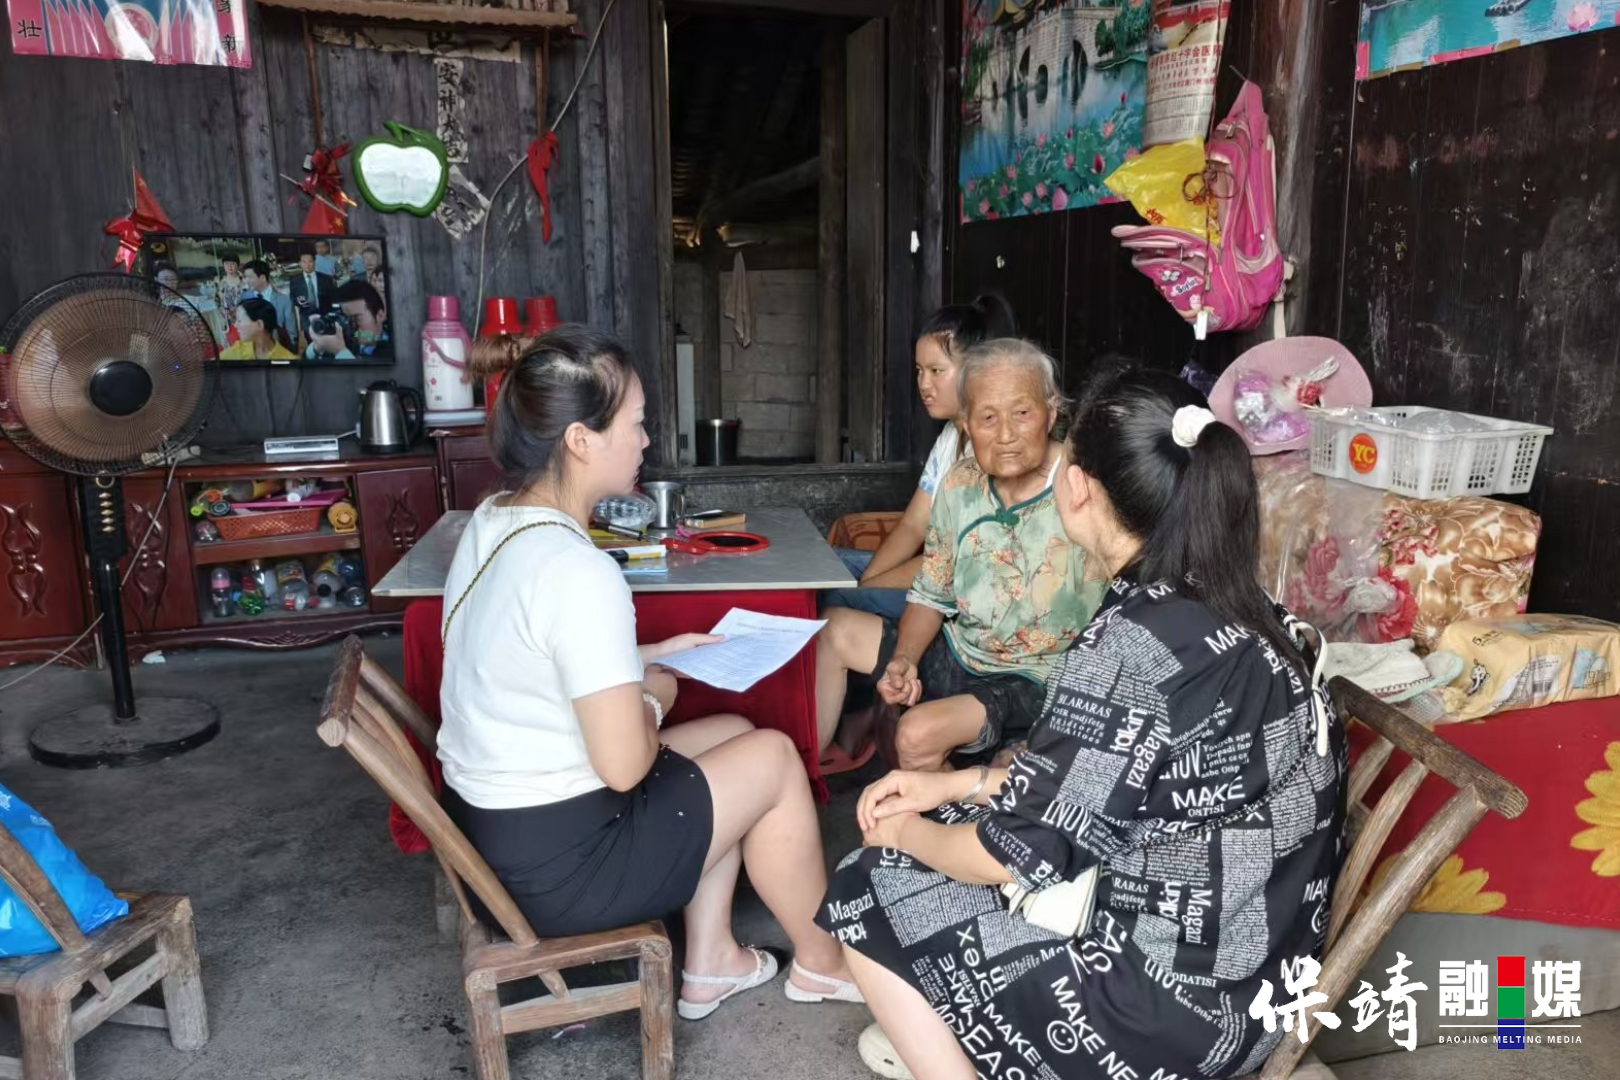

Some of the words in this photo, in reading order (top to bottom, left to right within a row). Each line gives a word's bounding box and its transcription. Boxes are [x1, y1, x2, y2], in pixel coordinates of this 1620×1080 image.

[18, 19, 42, 38] 壮
[1353, 443, 1376, 465] YC
[1172, 775, 1246, 810] MAKE
[827, 888, 875, 923] Magazi
[1051, 976, 1106, 1054] MAKE
[983, 1002, 1042, 1067] MAKE
